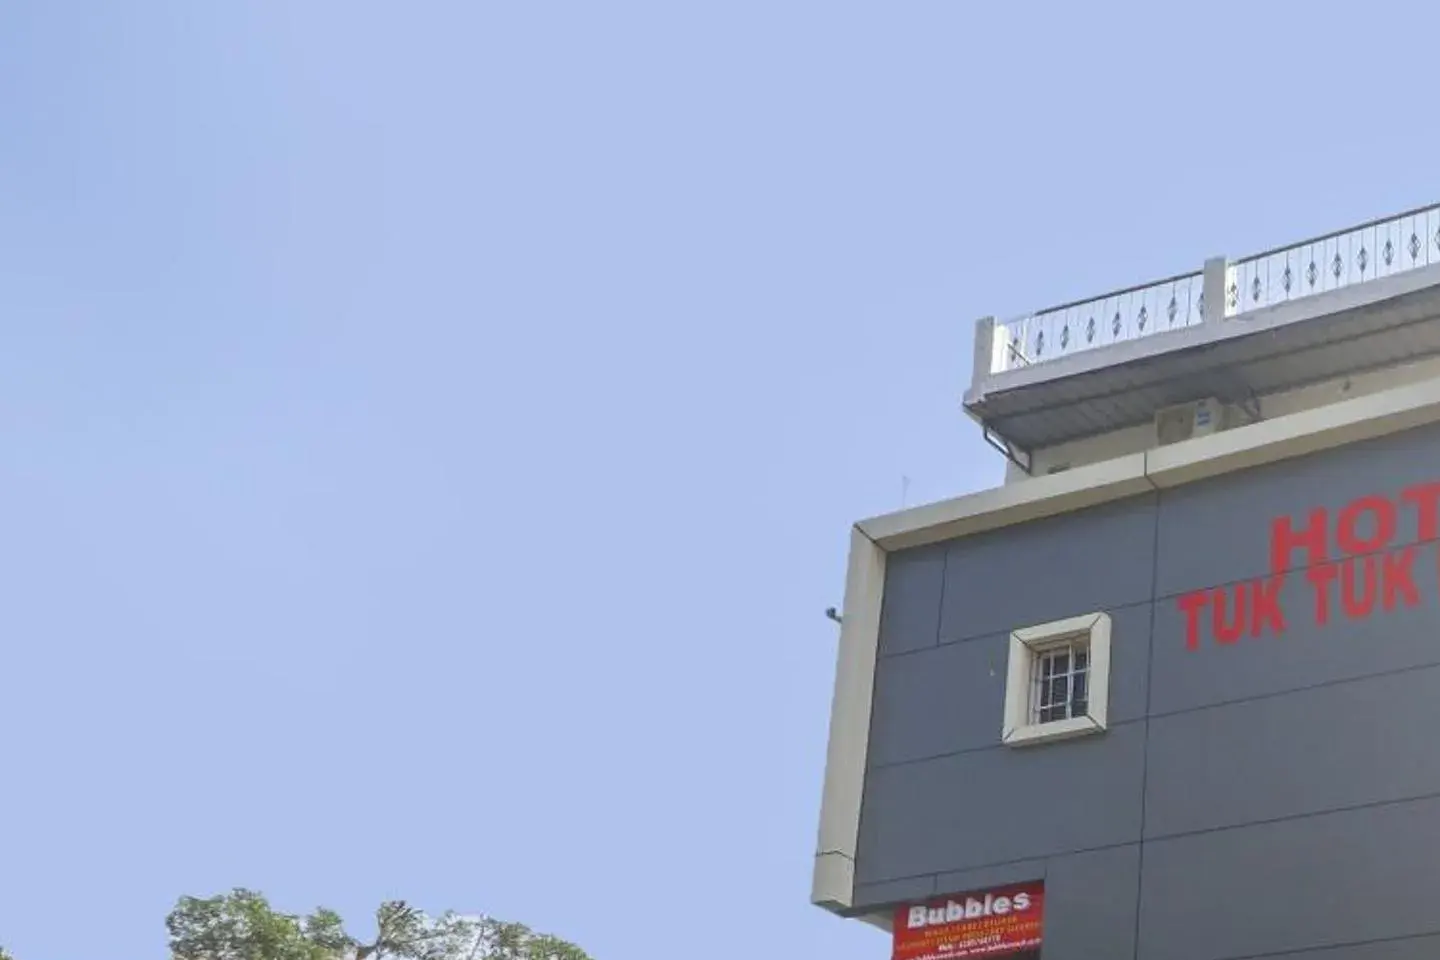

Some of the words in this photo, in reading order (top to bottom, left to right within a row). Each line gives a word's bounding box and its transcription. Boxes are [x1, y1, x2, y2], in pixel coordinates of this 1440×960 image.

[1177, 579, 1286, 651] TUK
[1307, 550, 1420, 626] TUK
[907, 892, 1032, 929] Bubbles
